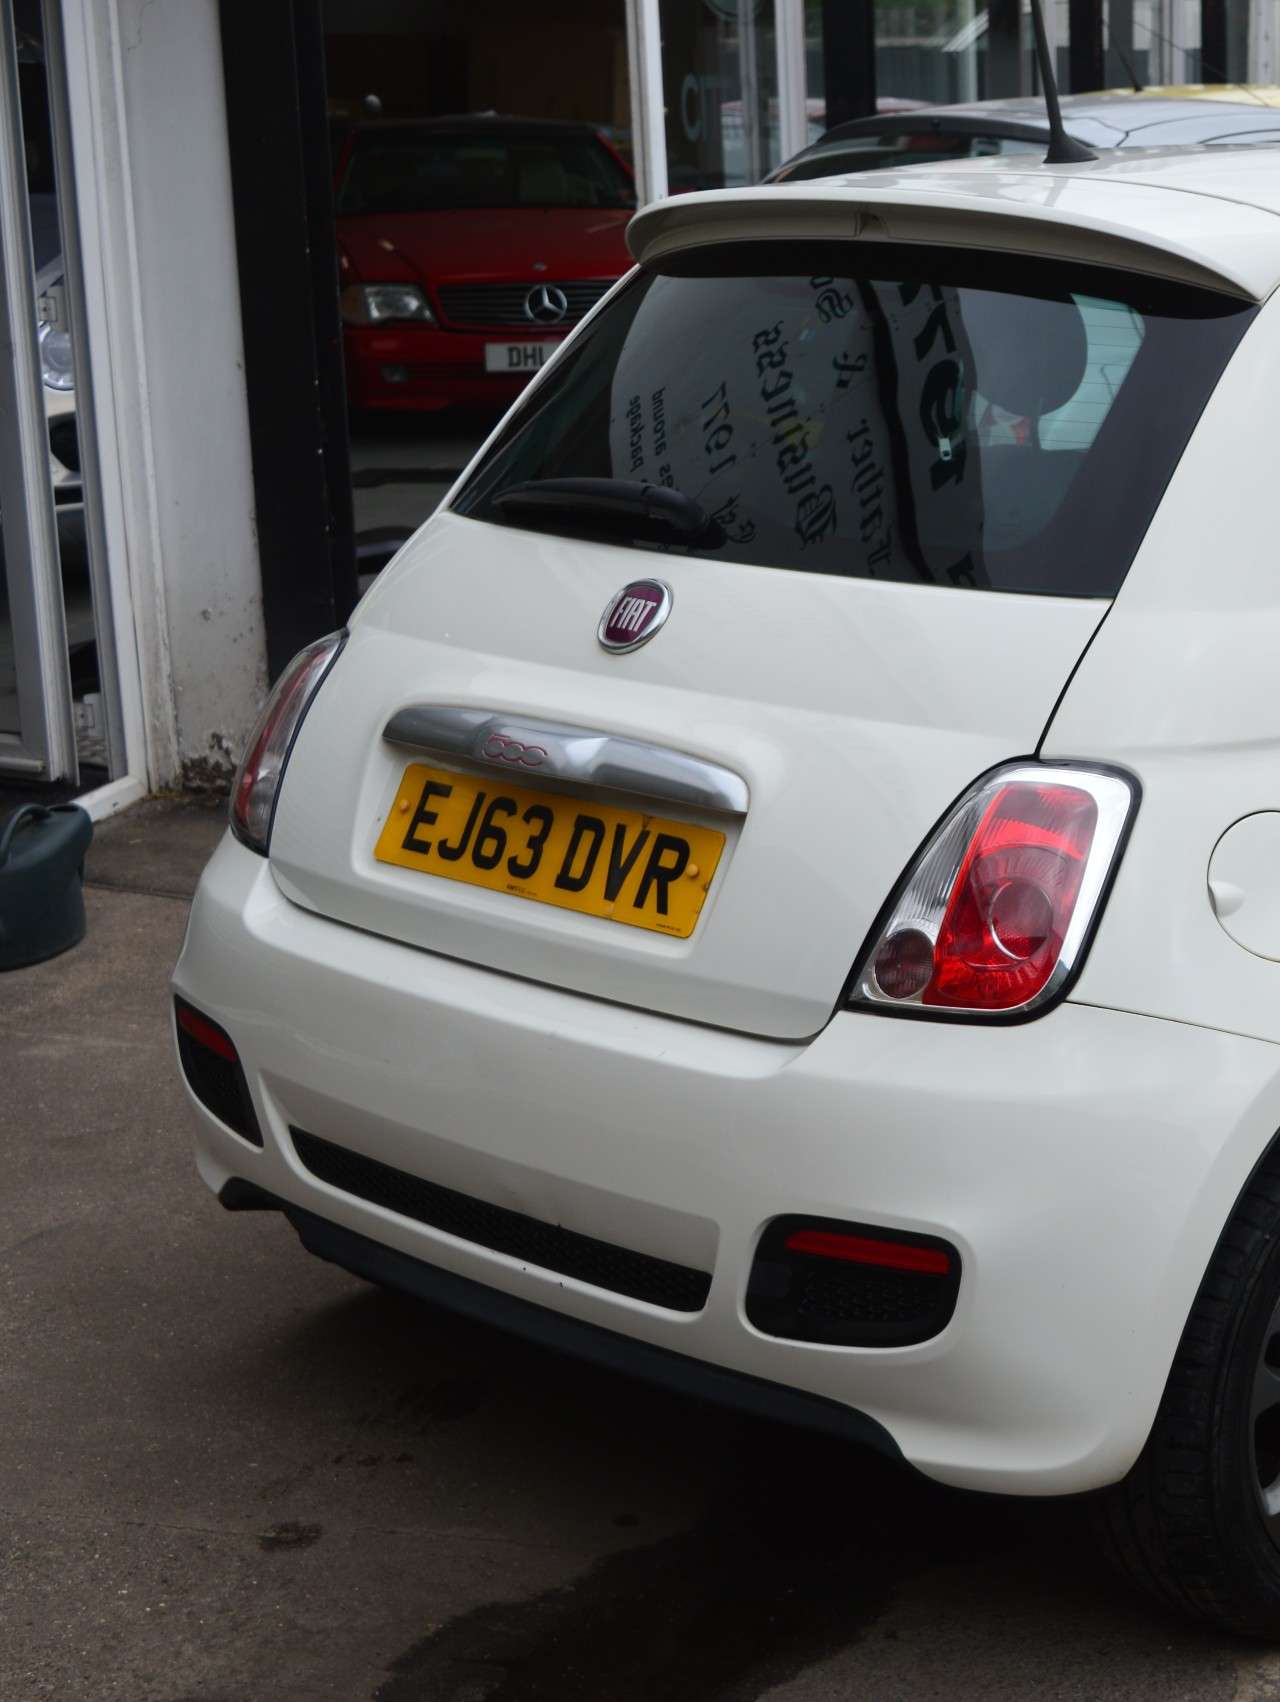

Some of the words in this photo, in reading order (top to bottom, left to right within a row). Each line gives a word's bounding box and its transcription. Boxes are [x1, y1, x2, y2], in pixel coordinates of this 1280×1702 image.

[613, 595, 657, 632] FIAT
[401, 779, 556, 881] EJ63
[554, 812, 692, 917] DVR
